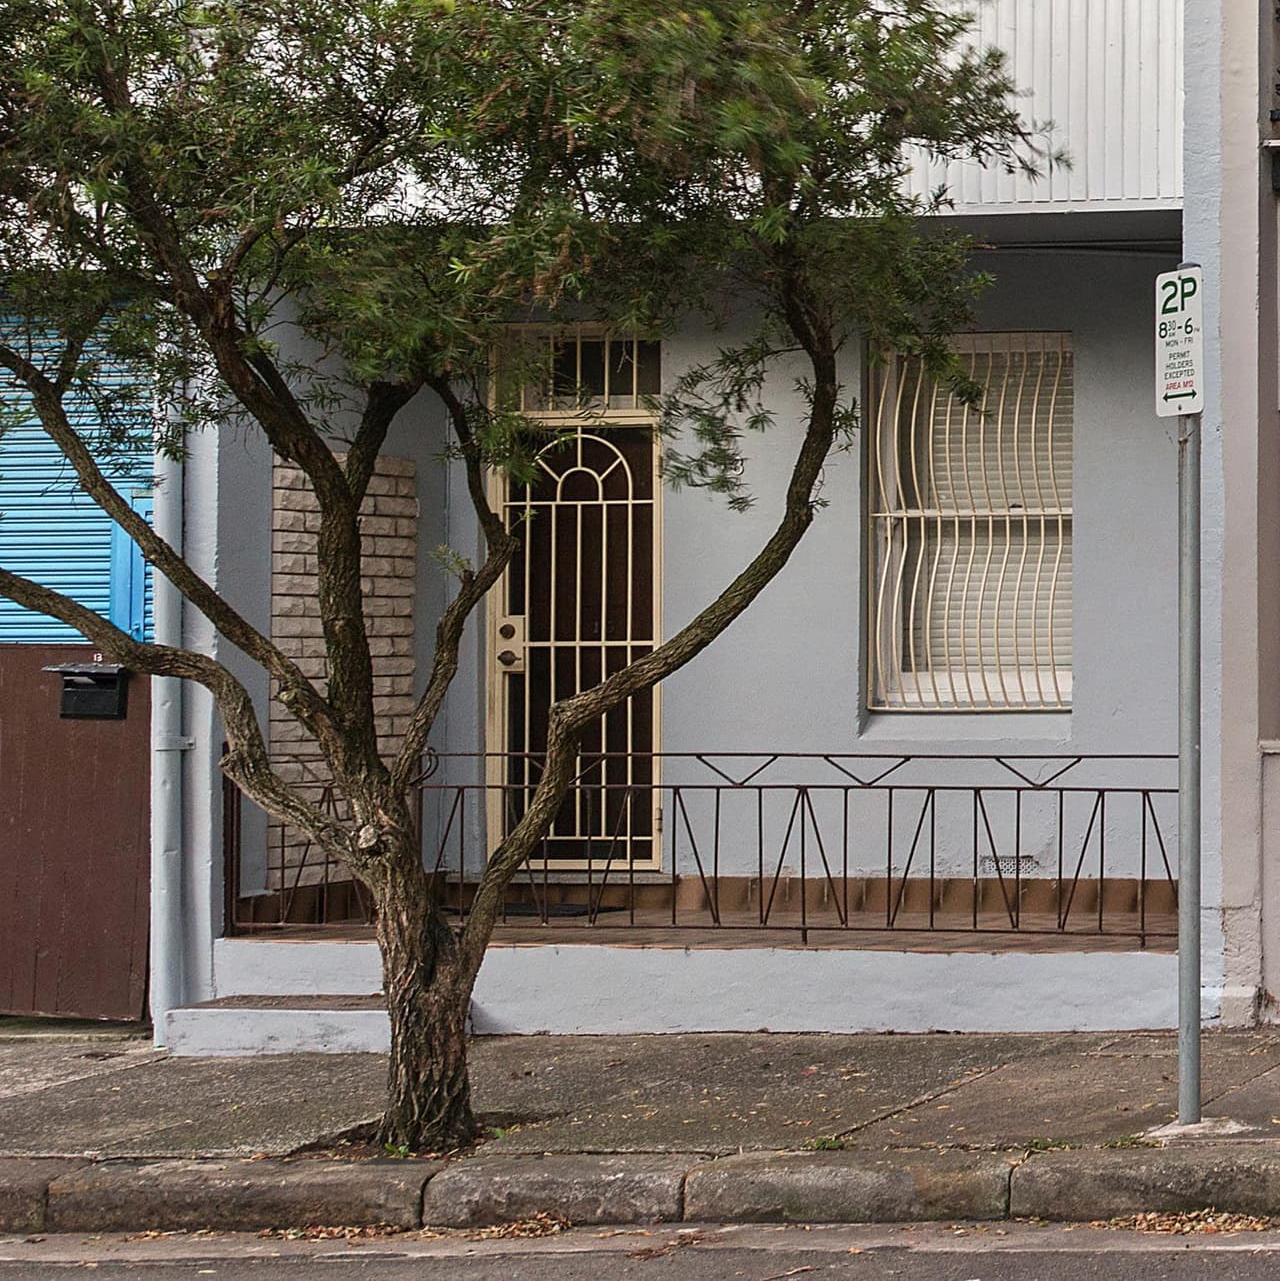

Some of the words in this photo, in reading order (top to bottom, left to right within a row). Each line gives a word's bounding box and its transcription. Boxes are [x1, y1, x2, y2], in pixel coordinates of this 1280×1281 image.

[1161, 277, 1197, 314] 2P
[1168, 351, 1190, 361] PERMIT
[1166, 360, 1193, 370] HOLDERS
[1164, 369, 1195, 380] EXCEPTED
[1166, 382, 1181, 390] AREA
[93, 653, 102, 662] 13
